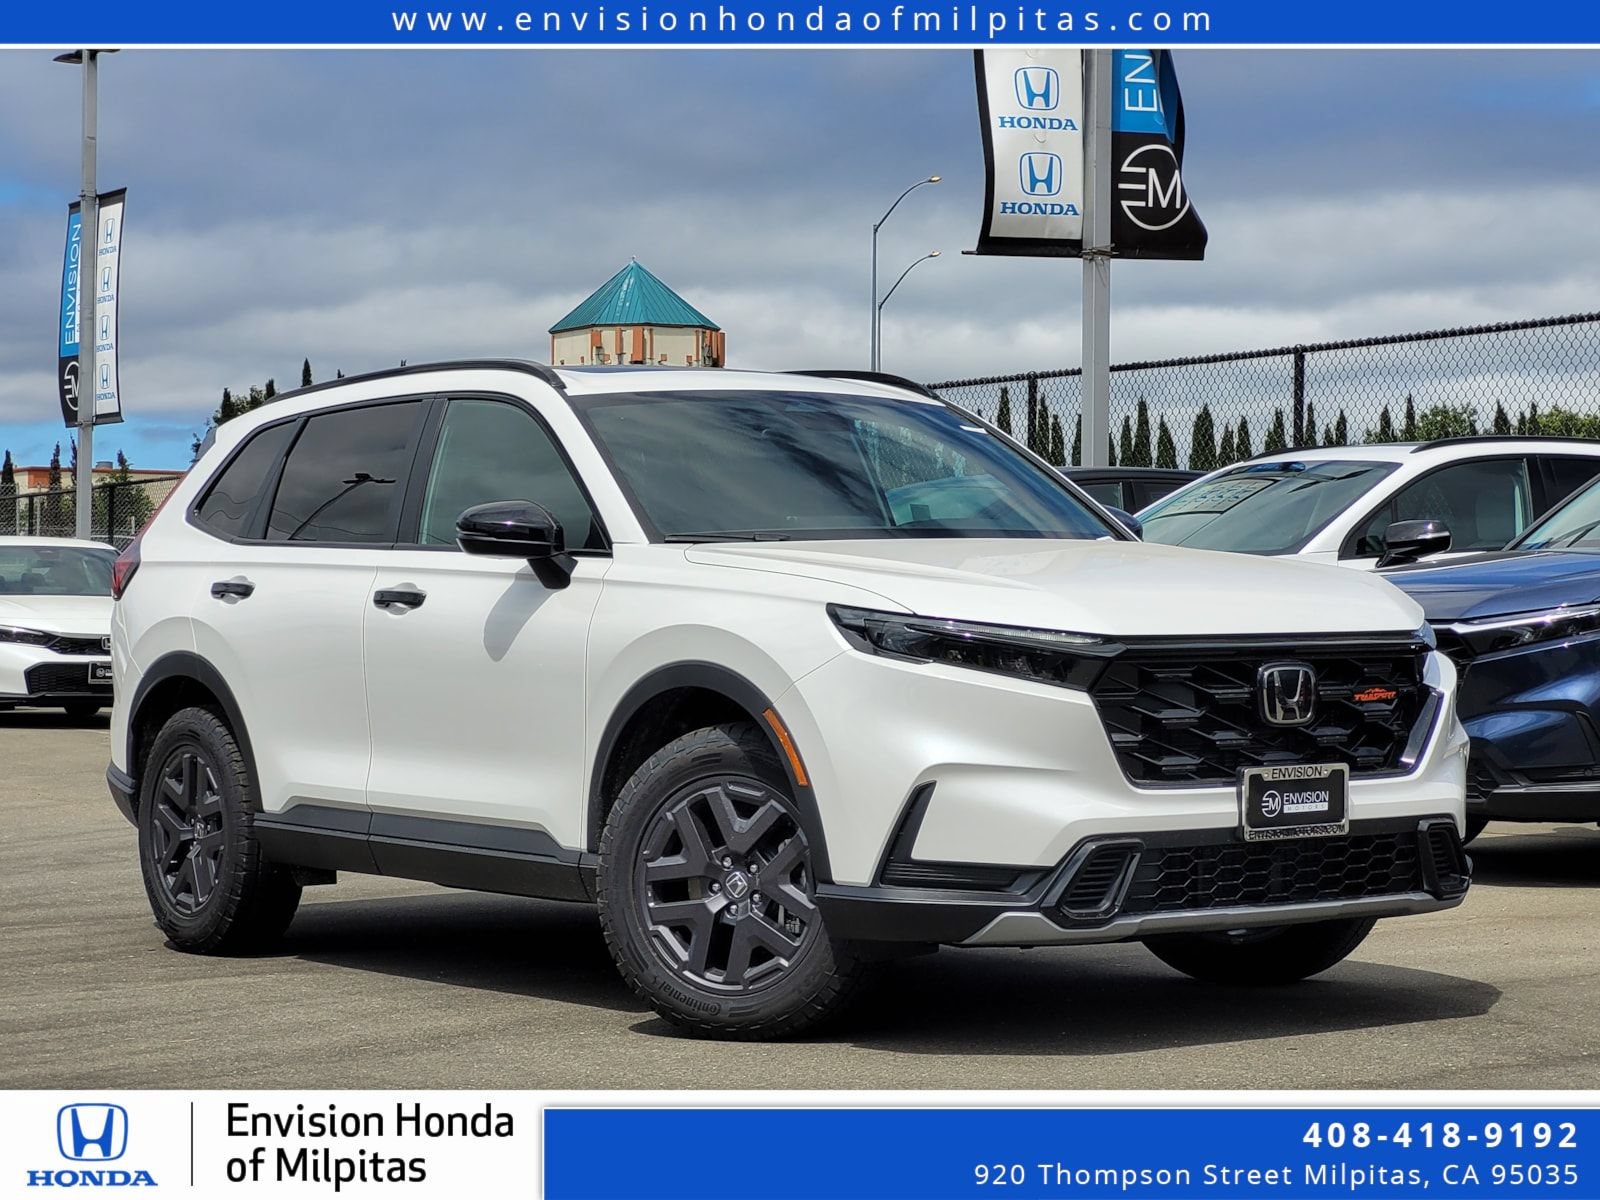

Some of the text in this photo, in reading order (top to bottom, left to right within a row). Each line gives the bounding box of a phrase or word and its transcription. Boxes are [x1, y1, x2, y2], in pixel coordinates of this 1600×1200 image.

[1124, 49, 1158, 112] EN
[998, 116, 1078, 131] HONDA
[1000, 201, 1080, 216] HONDA
[64, 223, 81, 345] ENVISION
[1271, 765, 1323, 780] ENVISION
[1283, 791, 1329, 805] ENVISION
[1248, 824, 1346, 841] ENVISIOOTORSCOM
[659, 980, 722, 1017] Continental
